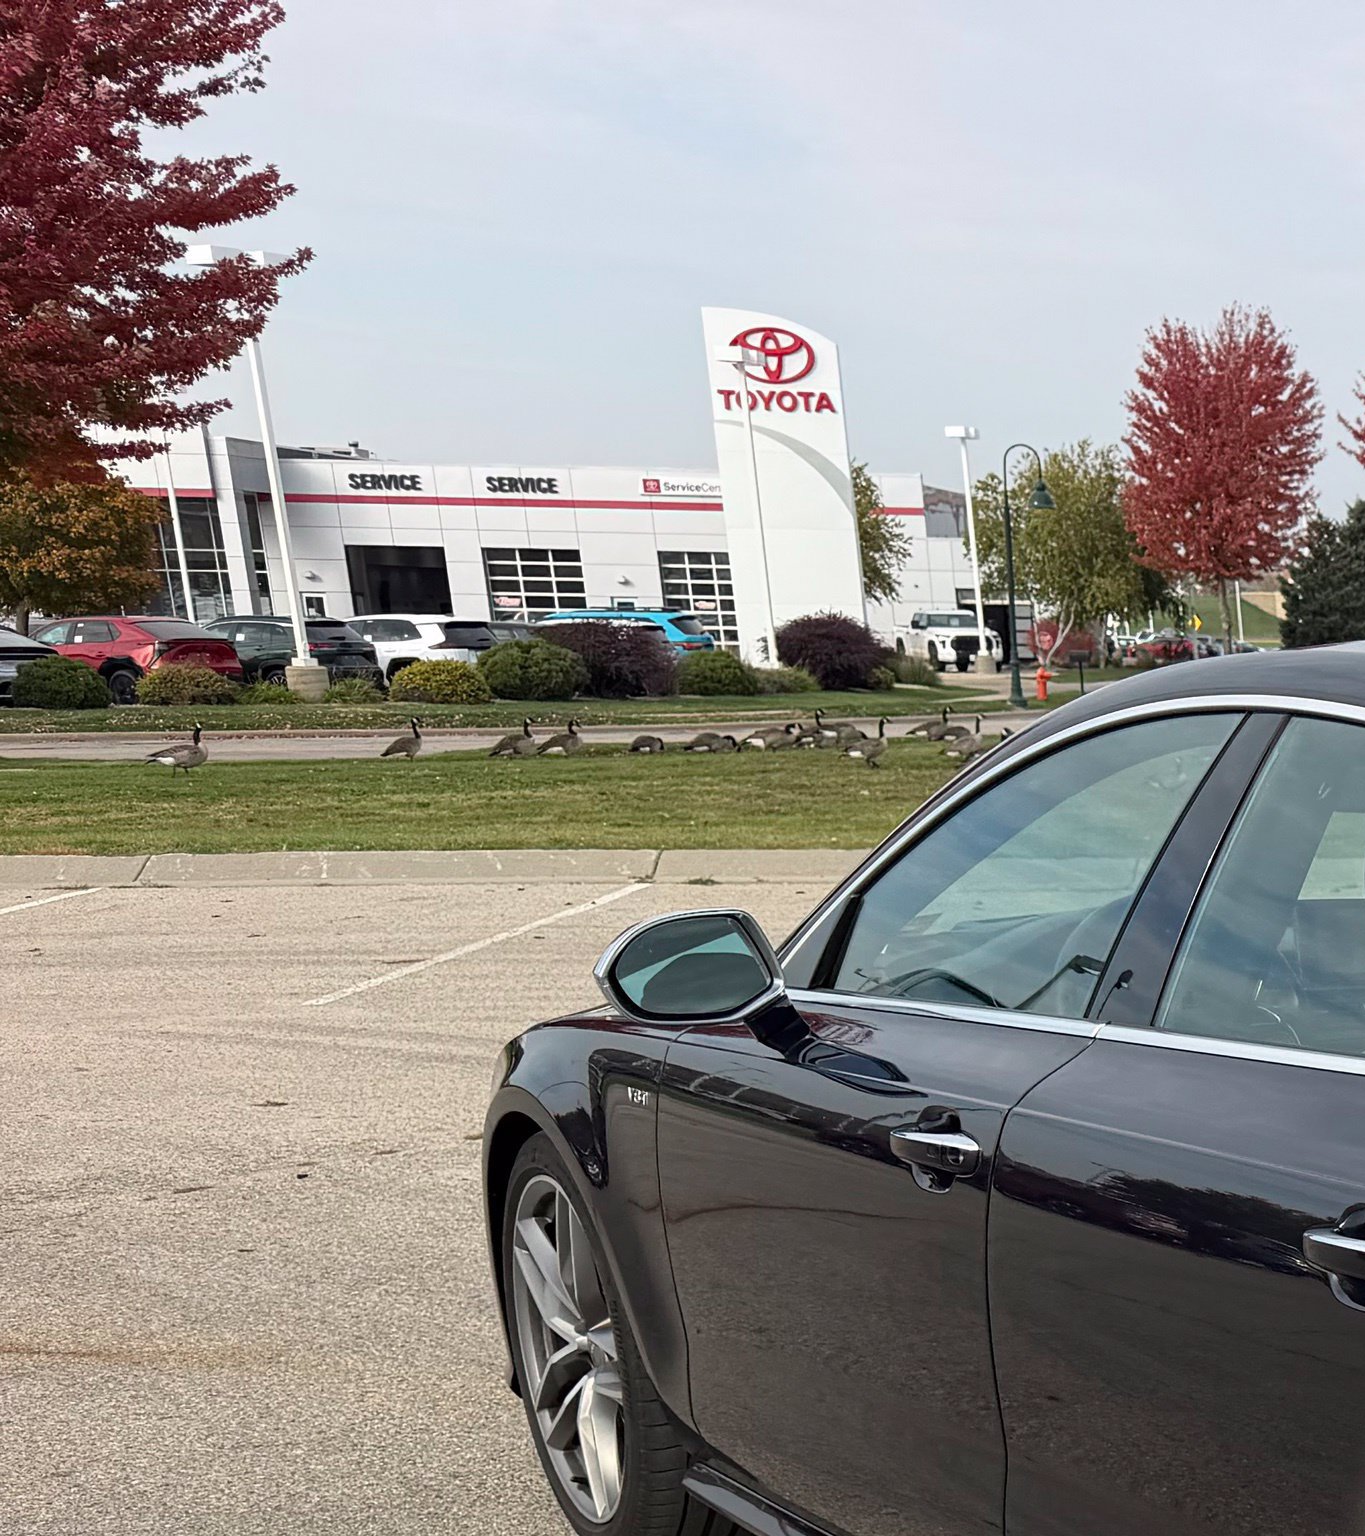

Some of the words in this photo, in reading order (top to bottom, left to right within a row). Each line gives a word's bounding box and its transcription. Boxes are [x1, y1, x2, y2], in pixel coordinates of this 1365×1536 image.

[717, 389, 838, 414] TOYOTA
[347, 473, 423, 491] SERVICE
[485, 476, 559, 494] SERVICE
